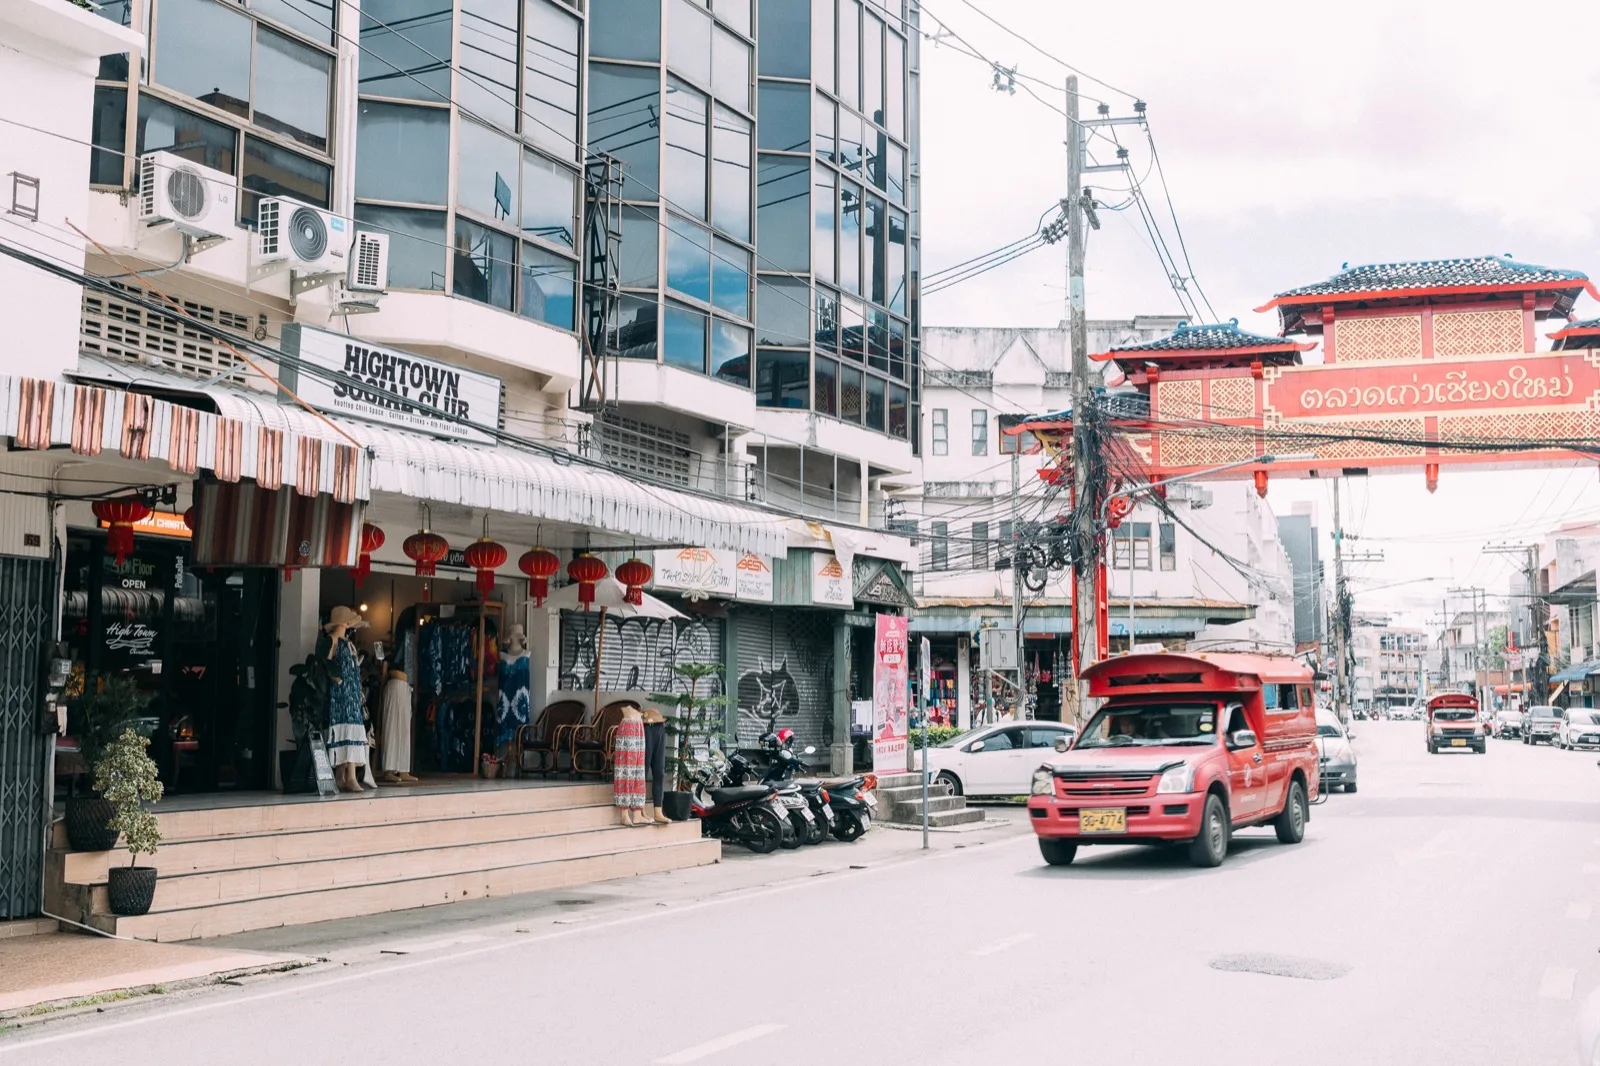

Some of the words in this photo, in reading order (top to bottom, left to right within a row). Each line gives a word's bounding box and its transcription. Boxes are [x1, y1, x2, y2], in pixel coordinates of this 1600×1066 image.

[344, 344, 460, 398] HIGHTOWN
[333, 370, 413, 414] SOCIAL
[418, 391, 470, 425] CLUB
[1300, 365, 1574, 409] ตลาดเก่าเชียงใหม่
[334, 399, 354, 410] Rooftop
[355, 403, 368, 412] Chill
[369, 406, 384, 416] Space
[388, 411, 405, 421] Coffee
[409, 416, 425, 425] Drinks
[439, 422, 451, 431] Floor
[452, 425, 468, 435] Lounge
[132, 558, 155, 576] Floor
[736, 559, 770, 573] BEST
[121, 578, 146, 589] OPEN
[106, 622, 133, 644] High
[132, 623, 158, 638] Town
